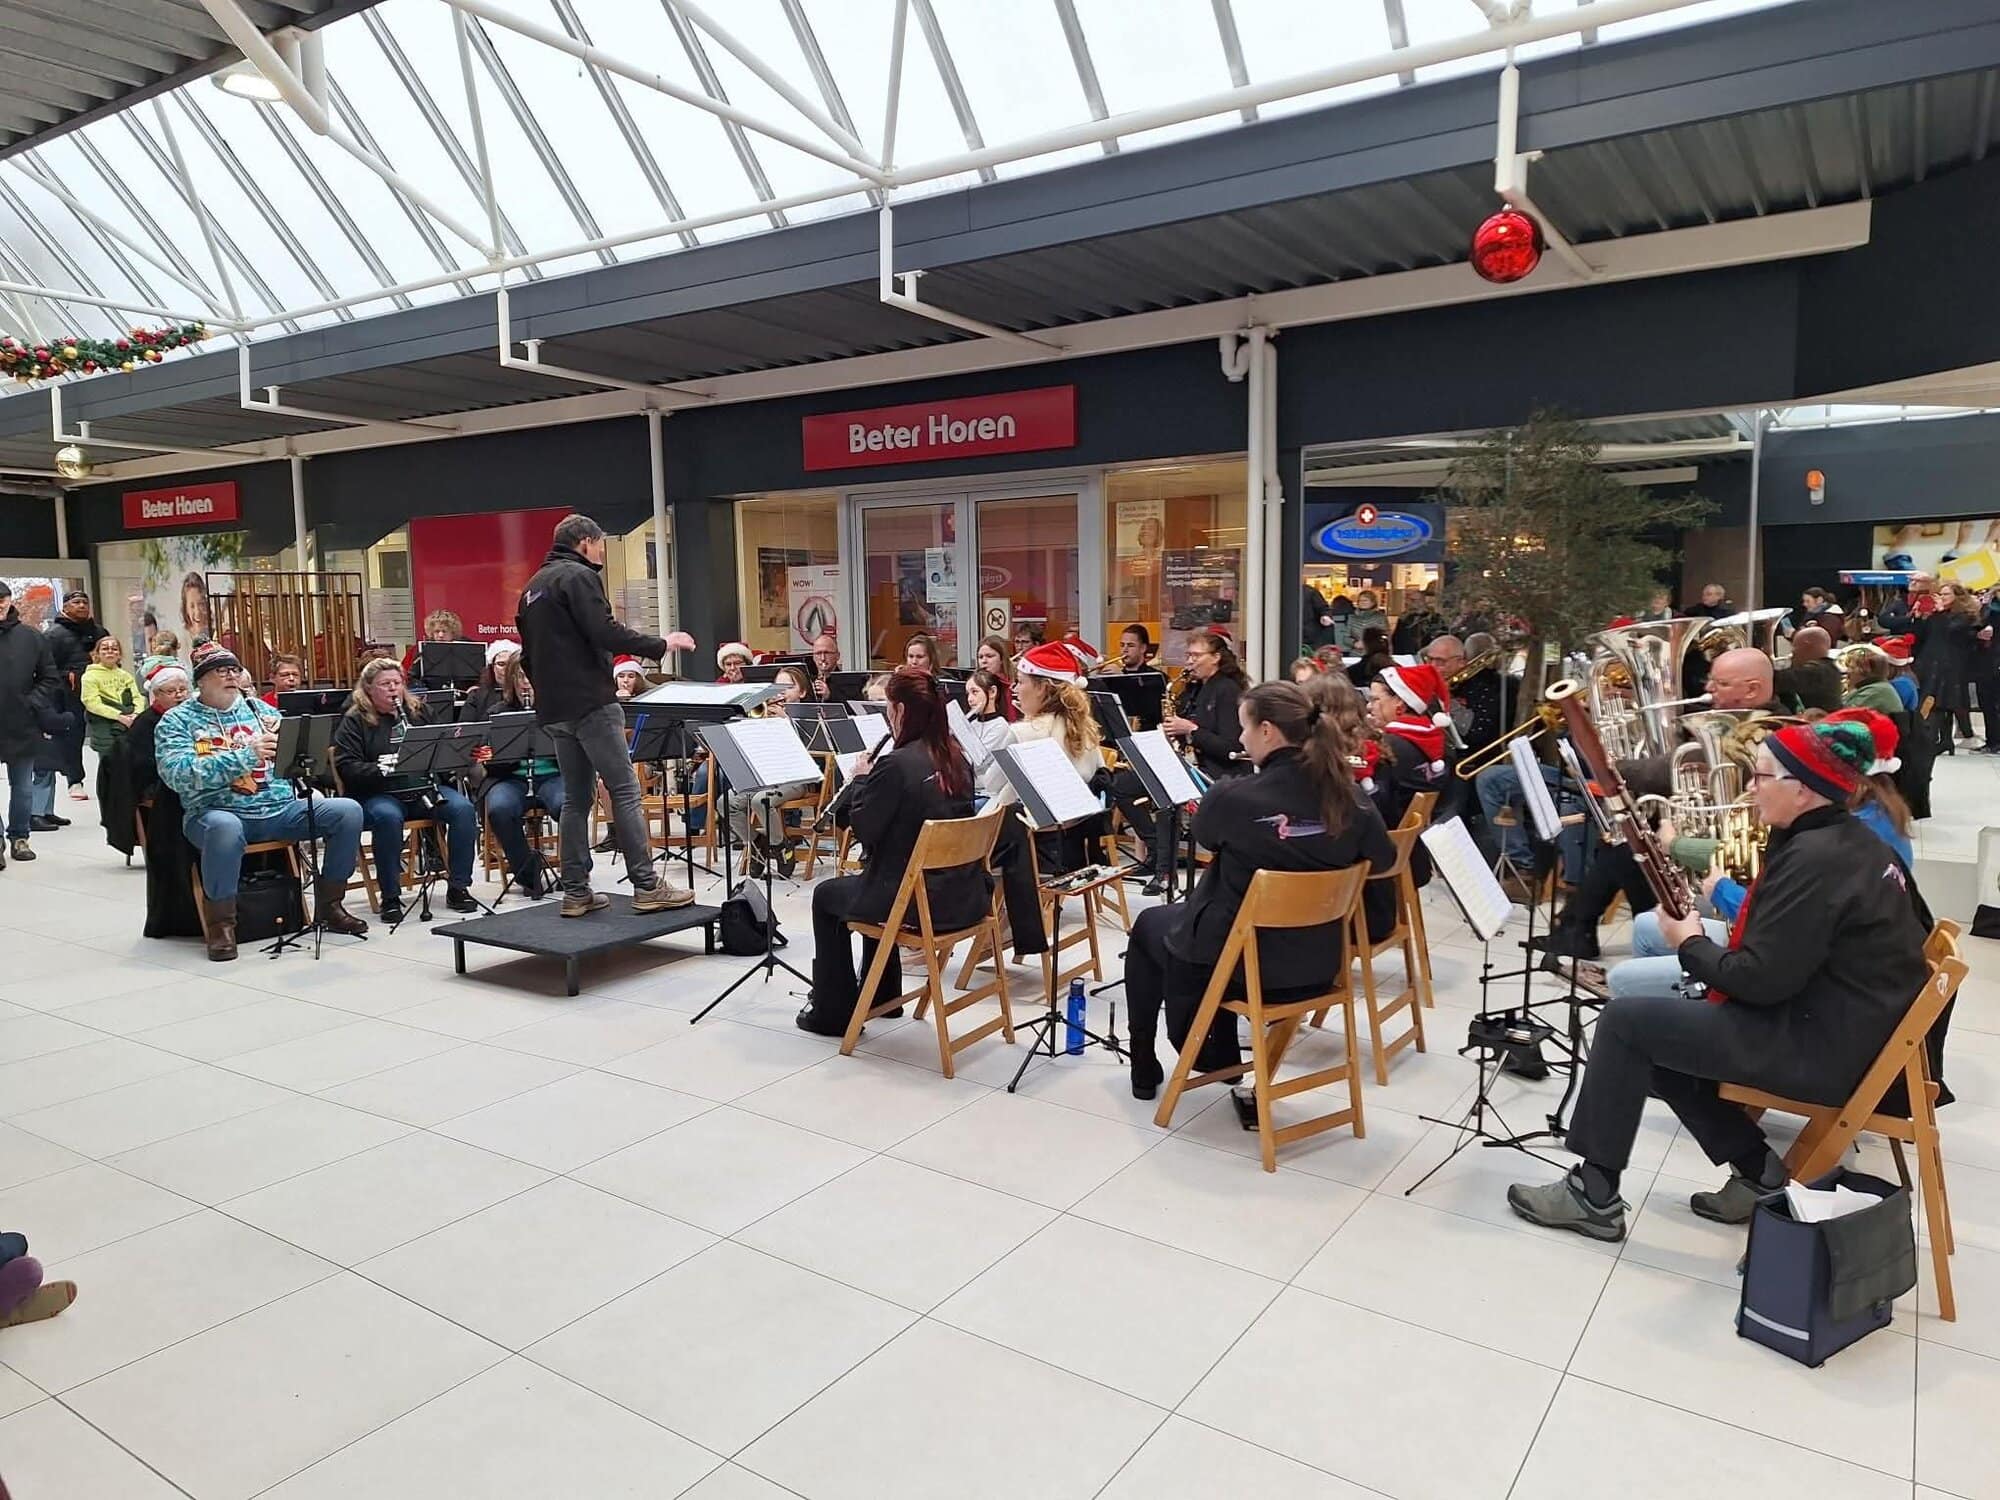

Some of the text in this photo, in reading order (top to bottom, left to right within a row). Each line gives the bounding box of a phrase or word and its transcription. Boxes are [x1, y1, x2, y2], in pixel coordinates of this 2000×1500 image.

[849, 414, 1016, 453] Beter Horen
[142, 496, 213, 518] Beter Horen
[478, 623, 518, 633] Beter hore
